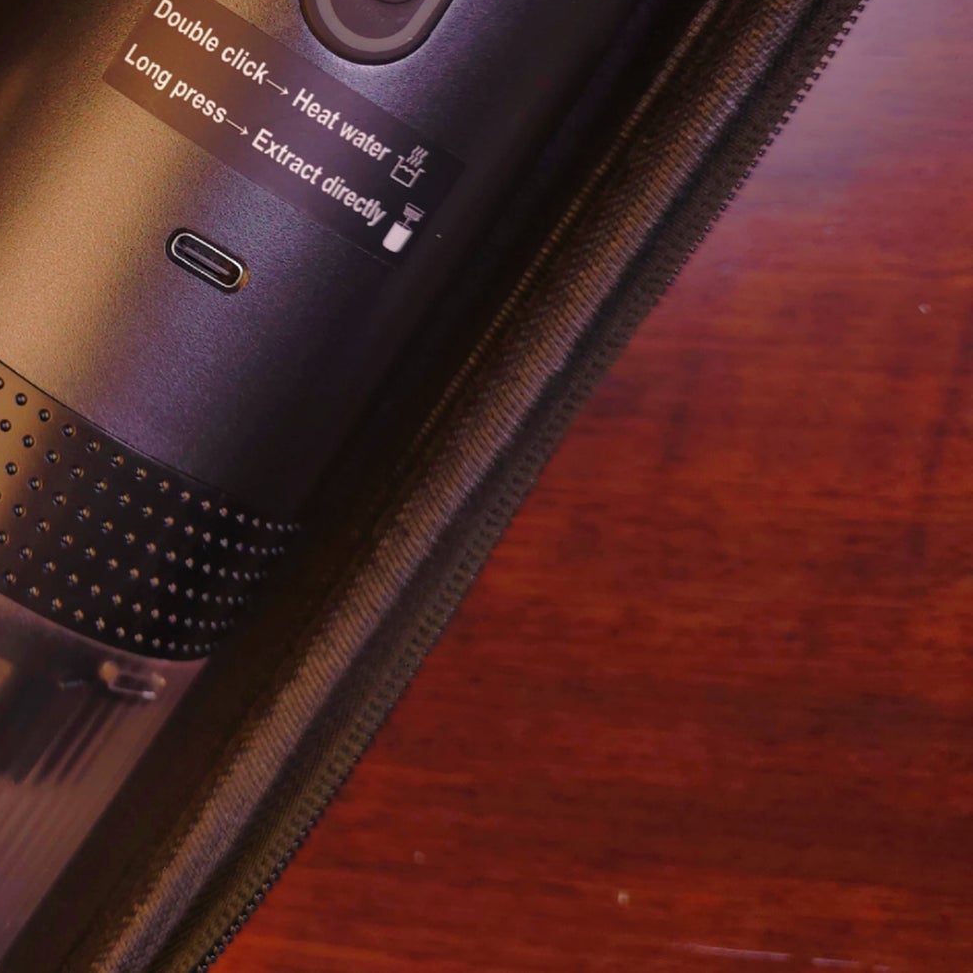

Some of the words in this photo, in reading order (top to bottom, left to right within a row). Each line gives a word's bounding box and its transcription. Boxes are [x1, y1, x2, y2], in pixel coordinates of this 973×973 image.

[124, 44, 172, 90] Long
[171, 81, 227, 124] press
[252, 129, 323, 184] Extract
[322, 175, 387, 226] directly
[221, 43, 268, 84] click
[292, 88, 339, 129] Heat
[340, 123, 391, 161] water
